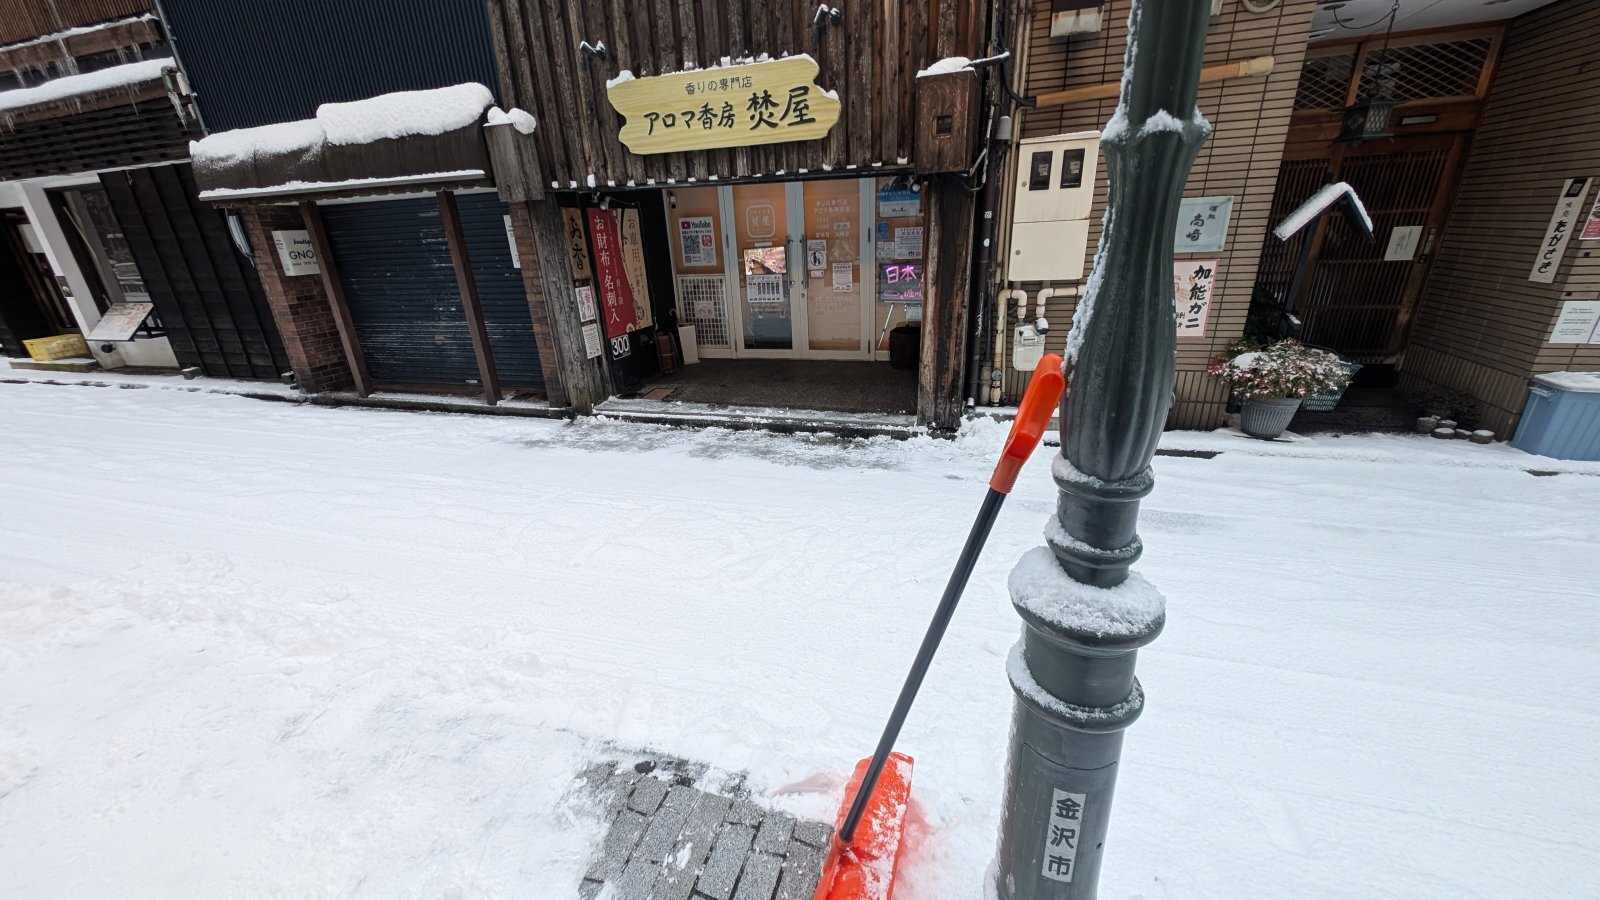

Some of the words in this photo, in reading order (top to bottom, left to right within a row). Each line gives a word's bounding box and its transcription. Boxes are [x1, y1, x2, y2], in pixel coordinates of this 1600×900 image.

[643, 101, 736, 136] アロマ香房
[746, 85, 816, 131] 焚屋
[685, 75, 752, 95] 香りの専門店
[570, 217, 587, 271] お香
[886, 265, 924, 284] 日本
[1185, 265, 1212, 329] 加能ガニ
[612, 336, 629, 356] 300
[1048, 798, 1081, 876] 金沢市
